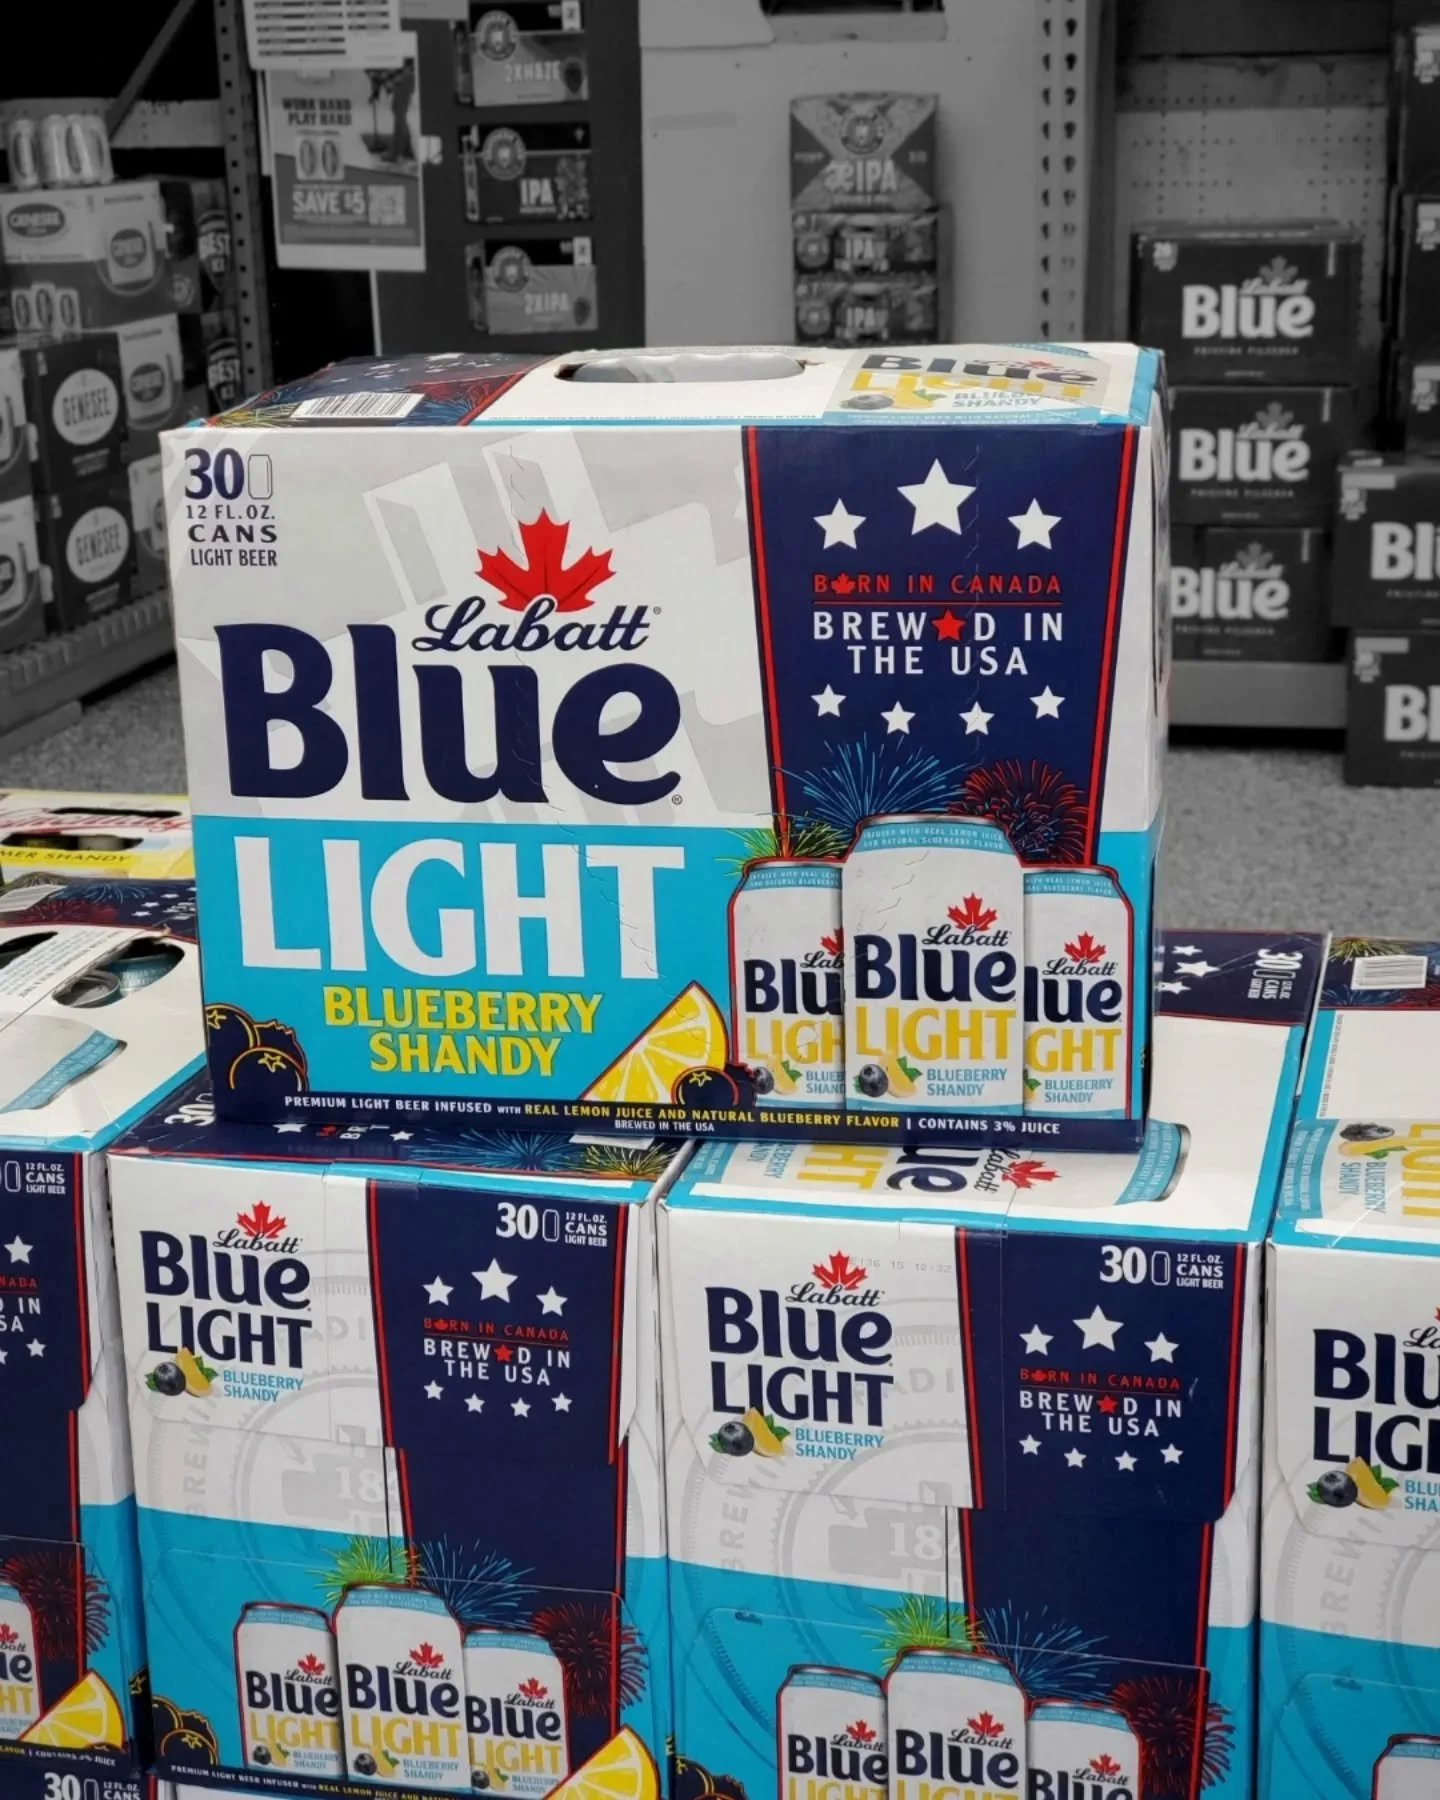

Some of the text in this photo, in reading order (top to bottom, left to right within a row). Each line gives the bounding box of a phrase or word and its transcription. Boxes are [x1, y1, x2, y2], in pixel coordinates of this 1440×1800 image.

[293, 191, 341, 214] SAVE
[520, 178, 554, 205] IPA
[1181, 284, 1315, 339] Blue
[861, 354, 1098, 385] Blue
[1178, 428, 1311, 482] Blue
[184, 447, 245, 500] 30
[186, 505, 207, 519] 12
[188, 523, 278, 544] CANS
[190, 549, 278, 568] LIGHT BEER
[813, 572, 1062, 595] BRN IN CANADA
[1170, 565, 1290, 619] Blue
[411, 595, 651, 652] Labatt
[812, 609, 1063, 642] BREWD IN
[846, 645, 1029, 676] THE USA
[213, 622, 682, 806] Blue
[44, 852, 131, 863] SHANDY
[233, 835, 685, 980] LIGHT
[922, 924, 1010, 947] Labatt
[854, 933, 1017, 1003] Blue
[1042, 957, 1117, 976] Labatt
[743, 958, 845, 1016] Blu
[321, 985, 604, 1034] BLUEBERRY
[855, 1006, 1017, 1061] LIGHT
[367, 1032, 563, 1078] SHANDY
[1025, 1027, 1122, 1073] GHT
[926, 1067, 1008, 1082] BLUEBERRY
[1044, 1078, 1114, 1091] BLUEBERRY
[926, 1083, 985, 1097] SHANDY
[1044, 1091, 1095, 1103] SHANDY
[284, 1095, 346, 1110] PREMIUM
[350, 1097, 391, 1111] LIGHT
[395, 1099, 430, 1113] BEER
[434, 1100, 493, 1114] INFUSED
[524, 1103, 560, 1117] REAL
[563, 1104, 611, 1118] LEMON
[615, 1106, 653, 1119] JUICE
[657, 1108, 688, 1120] AND
[692, 1108, 755, 1122] NATURAL
[759, 1111, 841, 1126] BLUEBERRY
[845, 1114, 900, 1128] FLAVOR
[918, 1117, 989, 1132] CONTAINS
[992, 1119, 1016, 1133] 3%
[1020, 1121, 1061, 1135] JUICE
[614, 1119, 715, 1133] BREWED IN THE USA
[25, 1162, 36, 1171] 12
[25, 1172, 66, 1184] CANS
[26, 1183, 47, 1194] LIGHT
[495, 1202, 539, 1240] 30
[564, 1222, 608, 1237] CANS
[565, 1212, 576, 1221] 12
[213, 1228, 301, 1254] Labatt
[564, 1234, 608, 1247] LIGHT BEER
[140, 1230, 311, 1312] Blue
[1100, 1245, 1148, 1285] 30
[1176, 1253, 1189, 1263] 12
[1176, 1263, 1224, 1278] CANS
[785, 1281, 882, 1307] Labatt
[1176, 1277, 1224, 1289] LIGHT BEER
[19, 1297, 41, 1315] IN
[146, 1301, 312, 1369] LIGHT
[423, 1317, 569, 1341] BRN IN CANADA
[704, 1286, 893, 1366] Blue
[423, 1338, 571, 1369] BREWD IN
[223, 1370, 304, 1391] BLUEBERRY
[444, 1359, 550, 1387] THE USA
[1020, 1367, 1181, 1390] BRN IN CANADA
[223, 1384, 280, 1403] SHANDY
[710, 1361, 894, 1427] LIGHT
[1019, 1390, 1182, 1418] BREWD IN
[795, 1428, 885, 1448] BLUEBERRY
[1041, 1411, 1160, 1438] THE USA
[795, 1444, 857, 1461] SHANDY
[393, 1661, 452, 1681] Labatt
[246, 1671, 339, 1718] Blue
[345, 1664, 459, 1719] Blue
[250, 1711, 340, 1751] LIGHT
[465, 1695, 562, 1741] Blue
[351, 1713, 463, 1758] LIGHT
[948, 1727, 1014, 1750] Labatt
[468, 1737, 563, 1775] LIGHT
[787, 1734, 889, 1786] Blue
[895, 1729, 1019, 1789] Blue
[43, 1771, 82, 1800] 30
